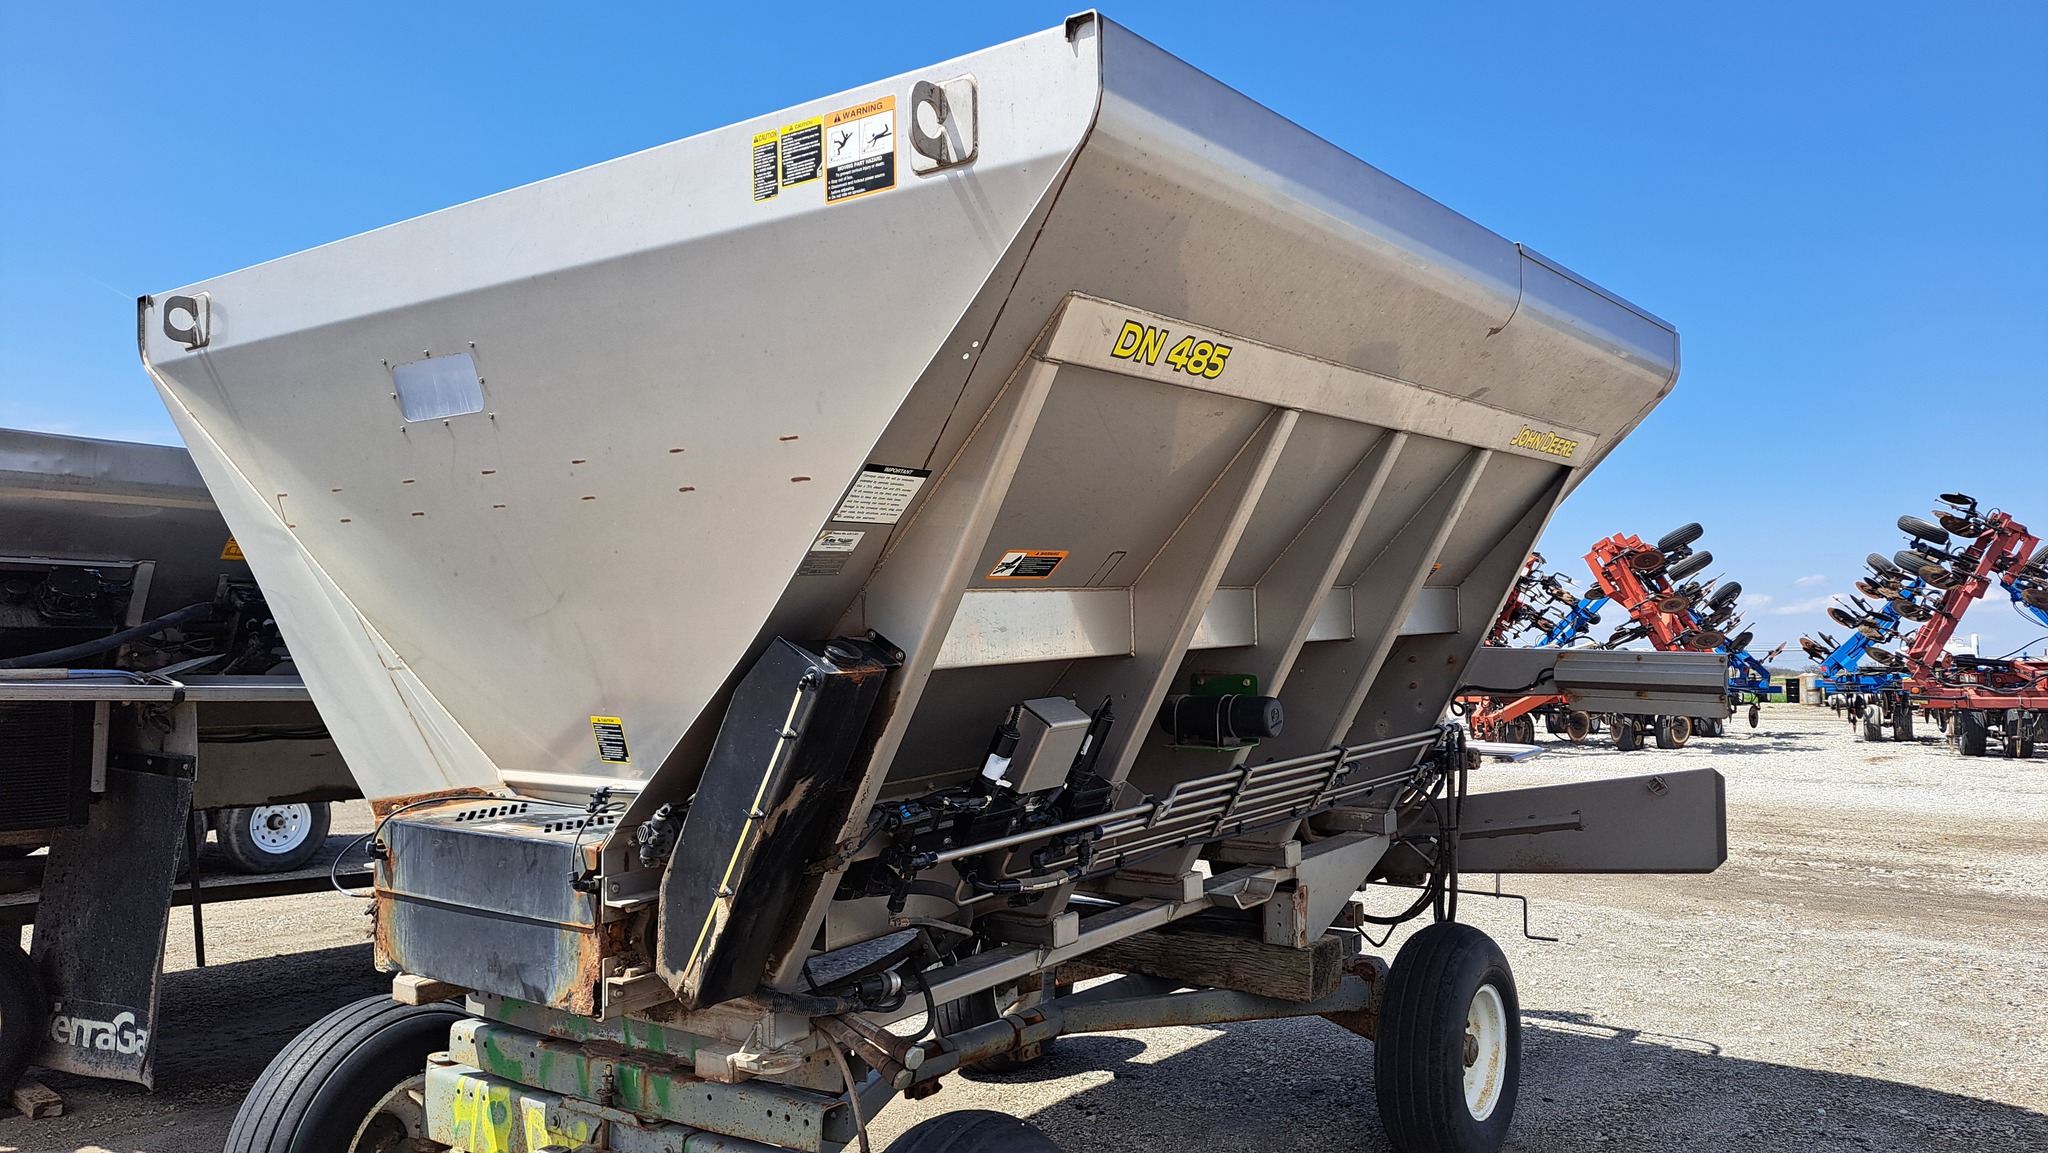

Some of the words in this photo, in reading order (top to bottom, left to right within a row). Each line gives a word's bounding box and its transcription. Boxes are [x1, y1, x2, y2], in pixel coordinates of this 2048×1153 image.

[842, 102, 883, 120] WARNING
[794, 120, 813, 129] CAUTION
[758, 131, 777, 142] CAUTION
[1110, 319, 1170, 366] DN
[1165, 335, 1233, 379] 485
[1510, 424, 1547, 451] JOHN
[1539, 431, 1579, 458] DEERE
[884, 467, 914, 475] IMPORTANT
